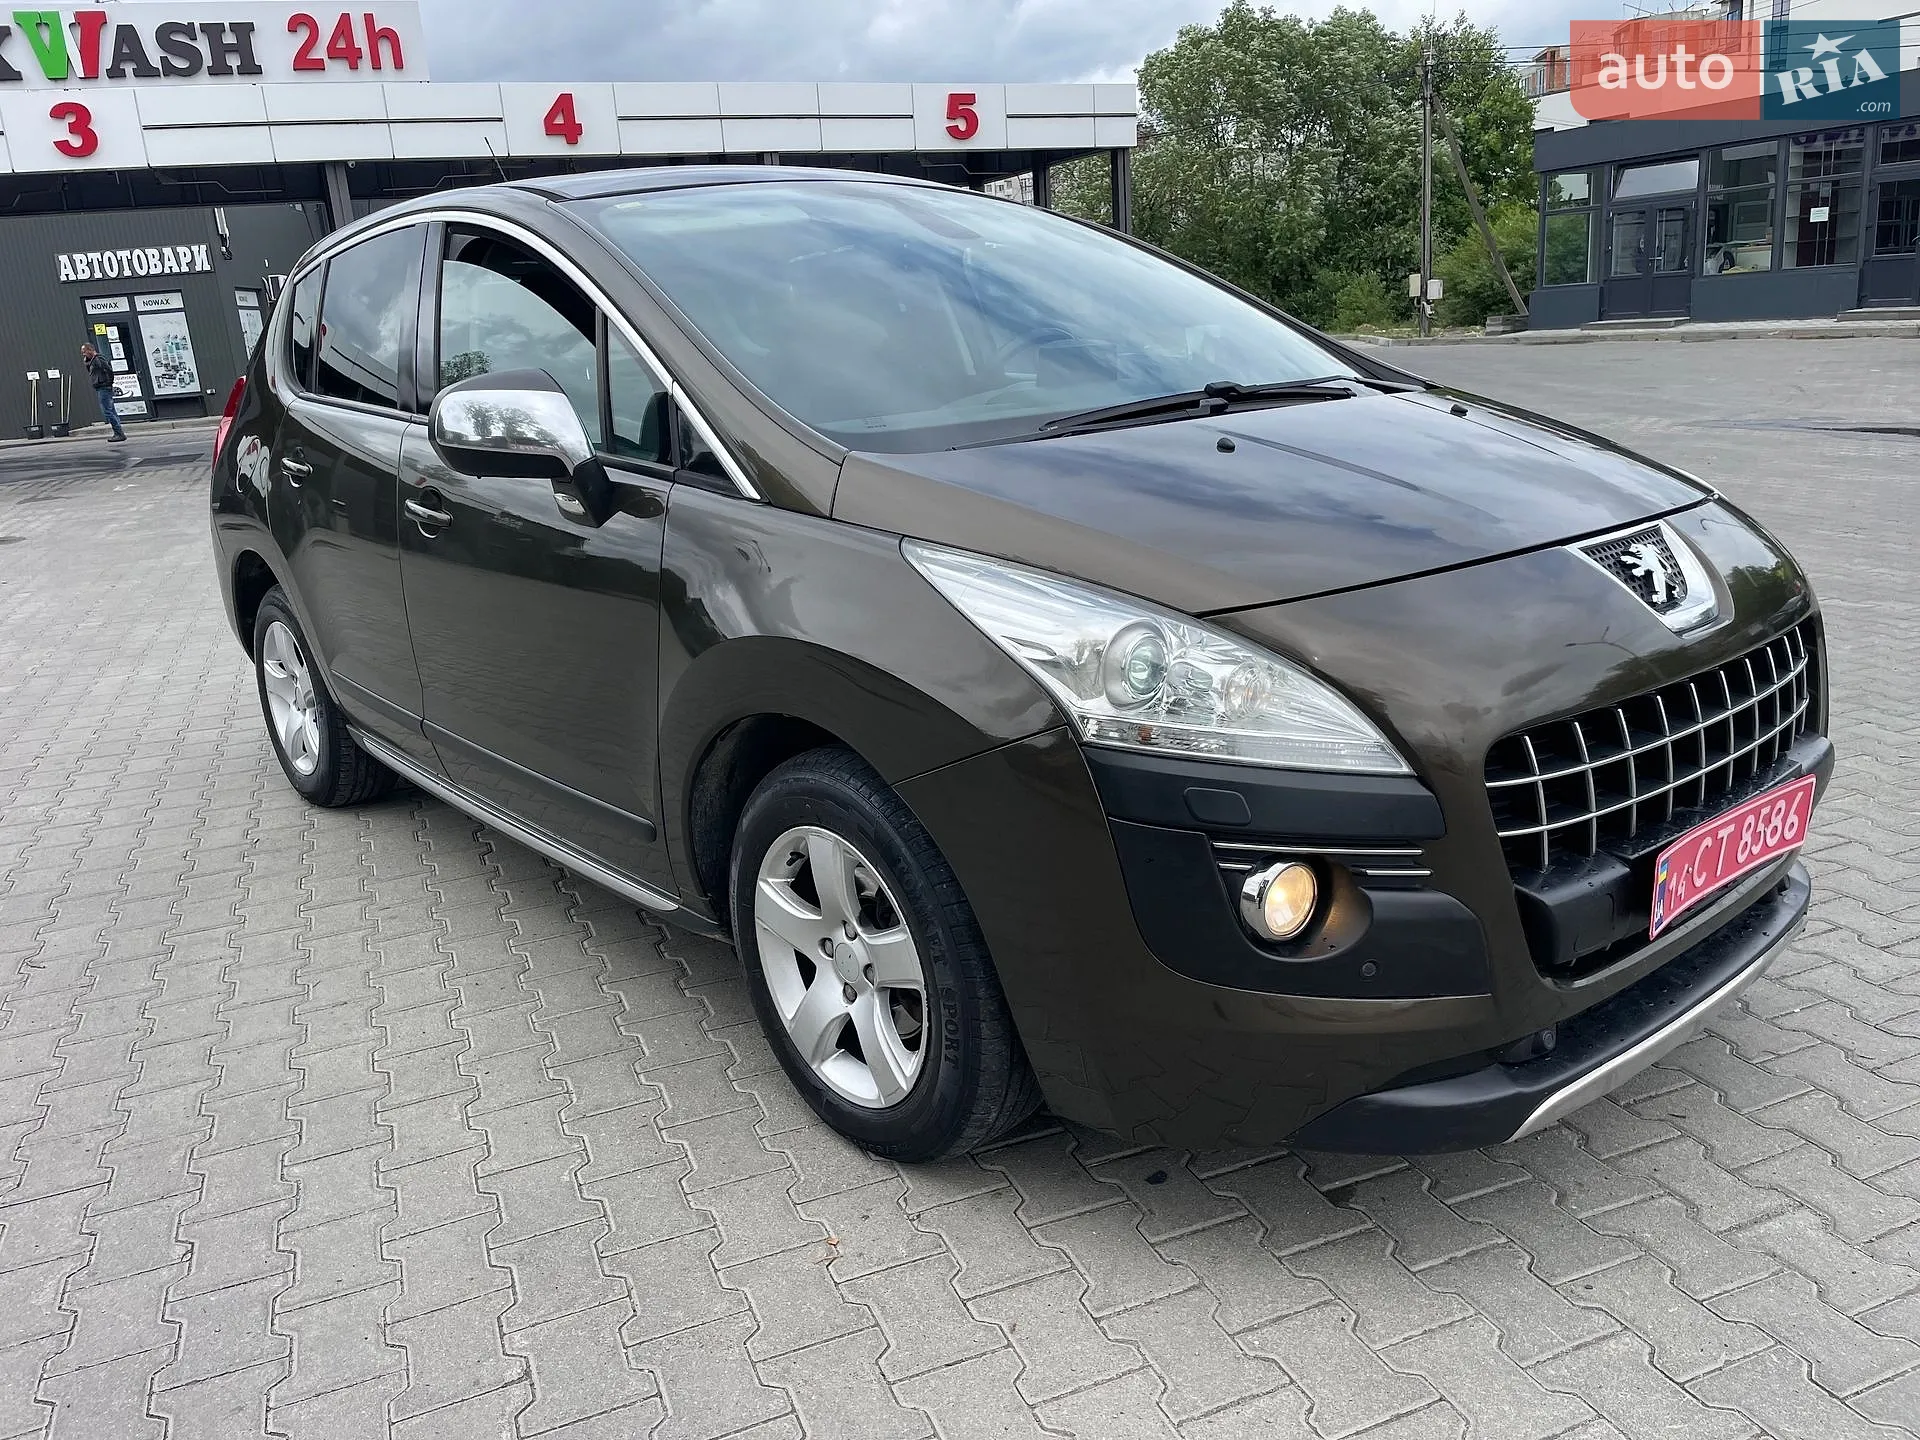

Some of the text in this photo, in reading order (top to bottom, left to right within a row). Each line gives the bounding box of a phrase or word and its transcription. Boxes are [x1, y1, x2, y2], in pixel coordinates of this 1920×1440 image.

[287, 12, 404, 71] 24h
[49, 102, 99, 157] 3
[543, 93, 583, 144] 4
[945, 93, 979, 140] 5
[58, 244, 211, 282] АВТОТОВАРИ
[90, 302, 119, 310] NOWAX
[142, 298, 171, 307] NOWAX
[1737, 791, 1803, 864] 8586
